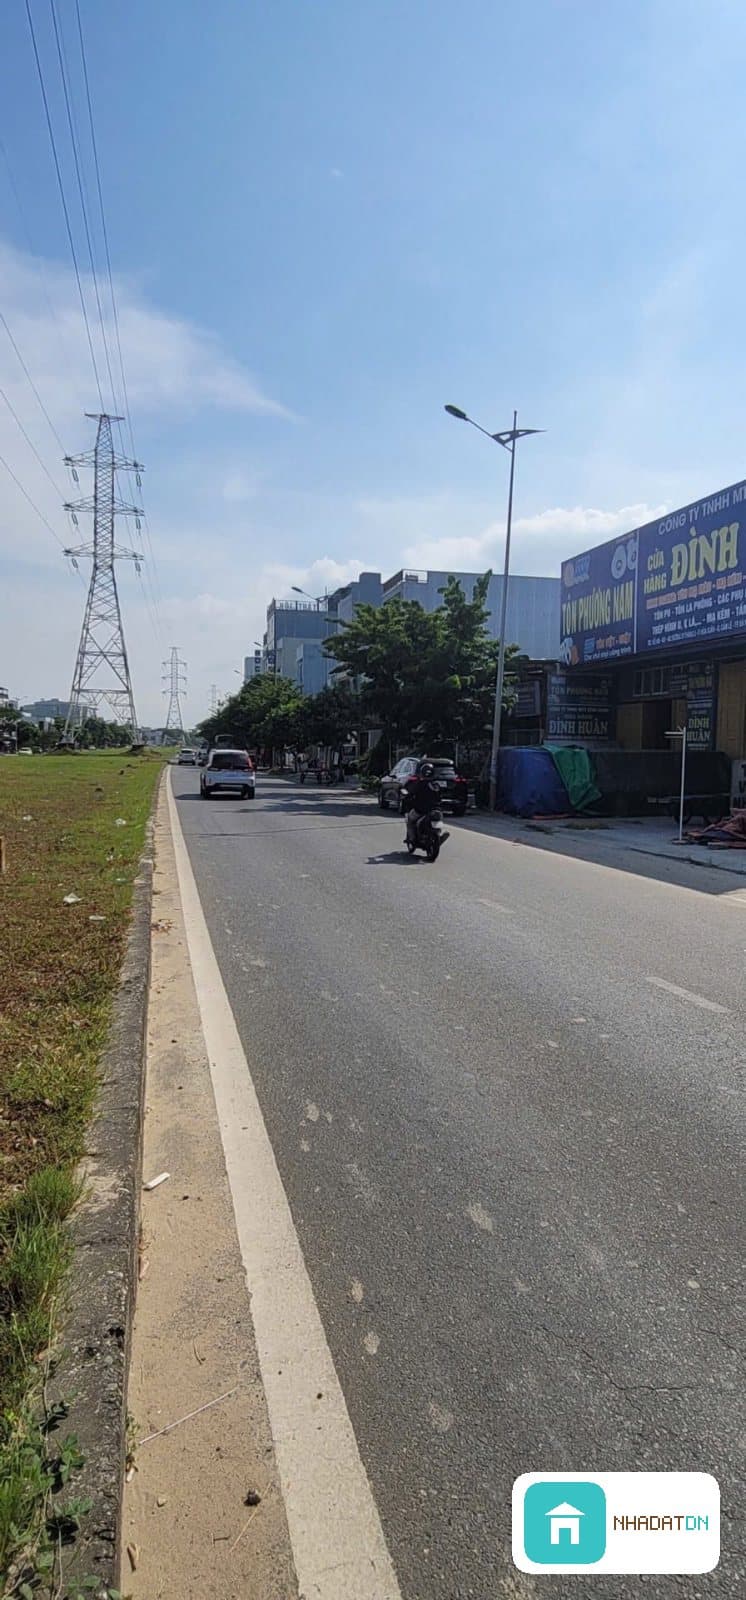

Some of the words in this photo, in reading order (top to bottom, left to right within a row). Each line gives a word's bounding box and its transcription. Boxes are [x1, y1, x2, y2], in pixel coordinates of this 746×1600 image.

[658, 513, 687, 535] CÔNG
[689, 506, 700, 523] TY
[702, 492, 729, 516] TNHH
[647, 547, 664, 571] CỬA
[670, 521, 740, 586] ĐÌNH
[643, 572, 667, 594] HÀNG
[613, 579, 634, 623] NAM
[549, 717, 576, 734] ĐÌNH
[578, 717, 609, 735] HUÂN
